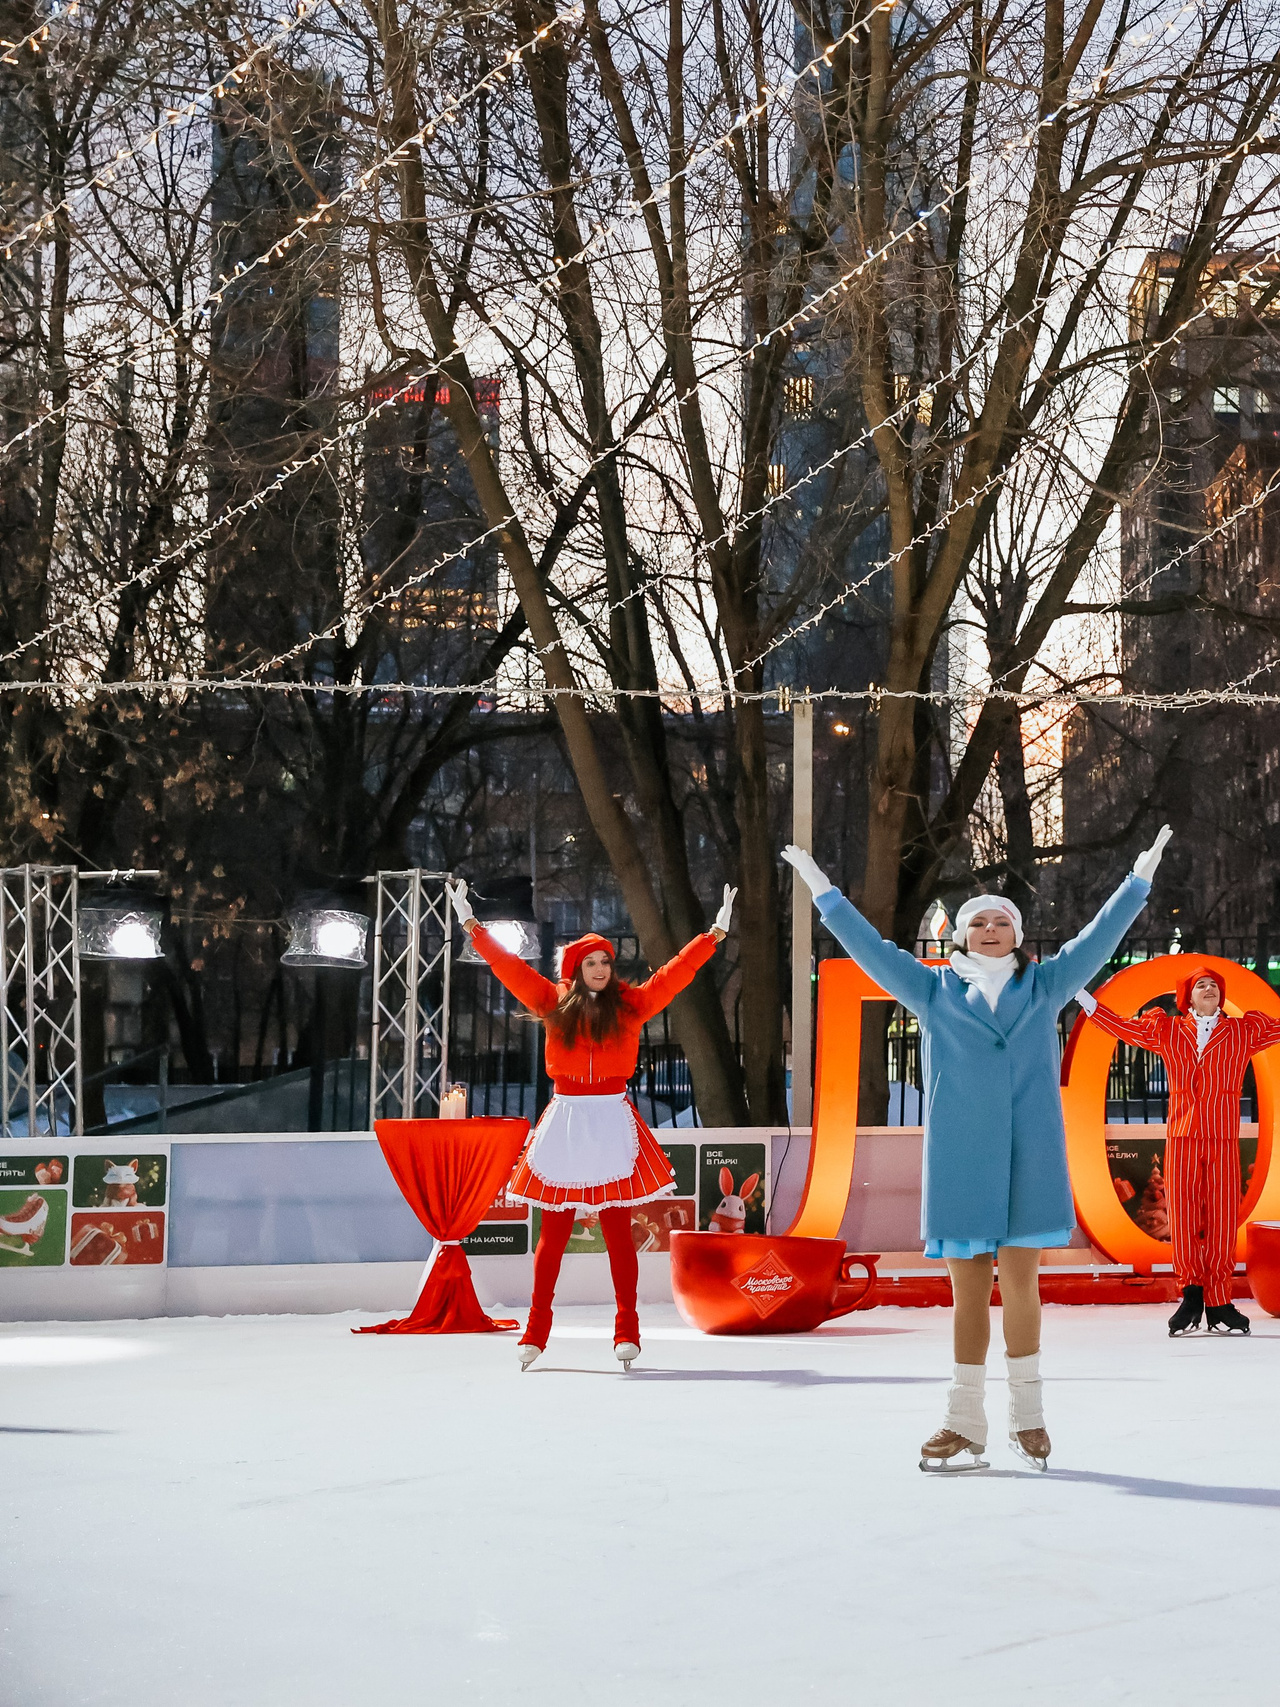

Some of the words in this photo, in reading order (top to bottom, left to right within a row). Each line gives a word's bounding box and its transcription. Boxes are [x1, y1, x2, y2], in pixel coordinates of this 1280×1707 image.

[706, 1150, 723, 1158] ВСЕ
[470, 1236, 483, 1244] НА
[740, 1274, 793, 1290] Московское
